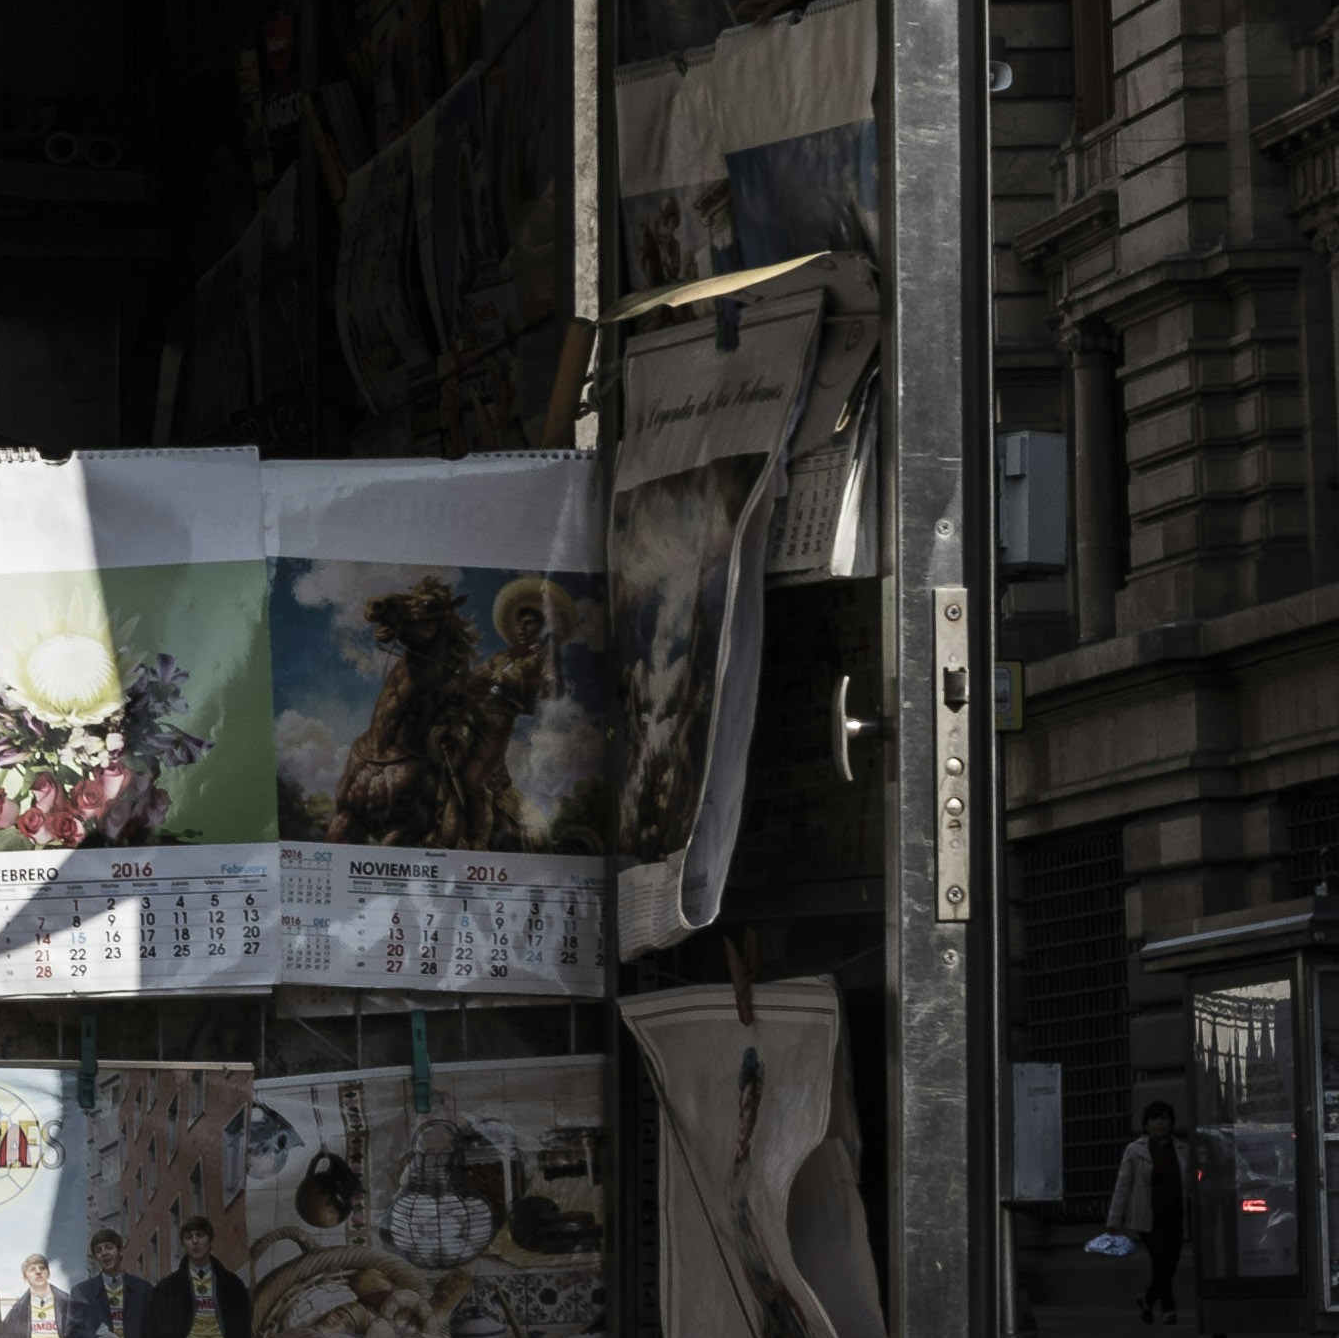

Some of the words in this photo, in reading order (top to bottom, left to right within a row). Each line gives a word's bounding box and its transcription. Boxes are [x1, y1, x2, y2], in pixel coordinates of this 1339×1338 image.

[111, 863, 153, 878] 2016
[349, 861, 439, 879] NOVIEMBRE
[467, 866, 508, 883] 2016
[36, 965, 53, 978] 28
[70, 964, 87, 977] 29
[387, 960, 403, 973] 27
[420, 962, 437, 974] 28
[455, 964, 473, 976] 29
[490, 965, 508, 977] 30
